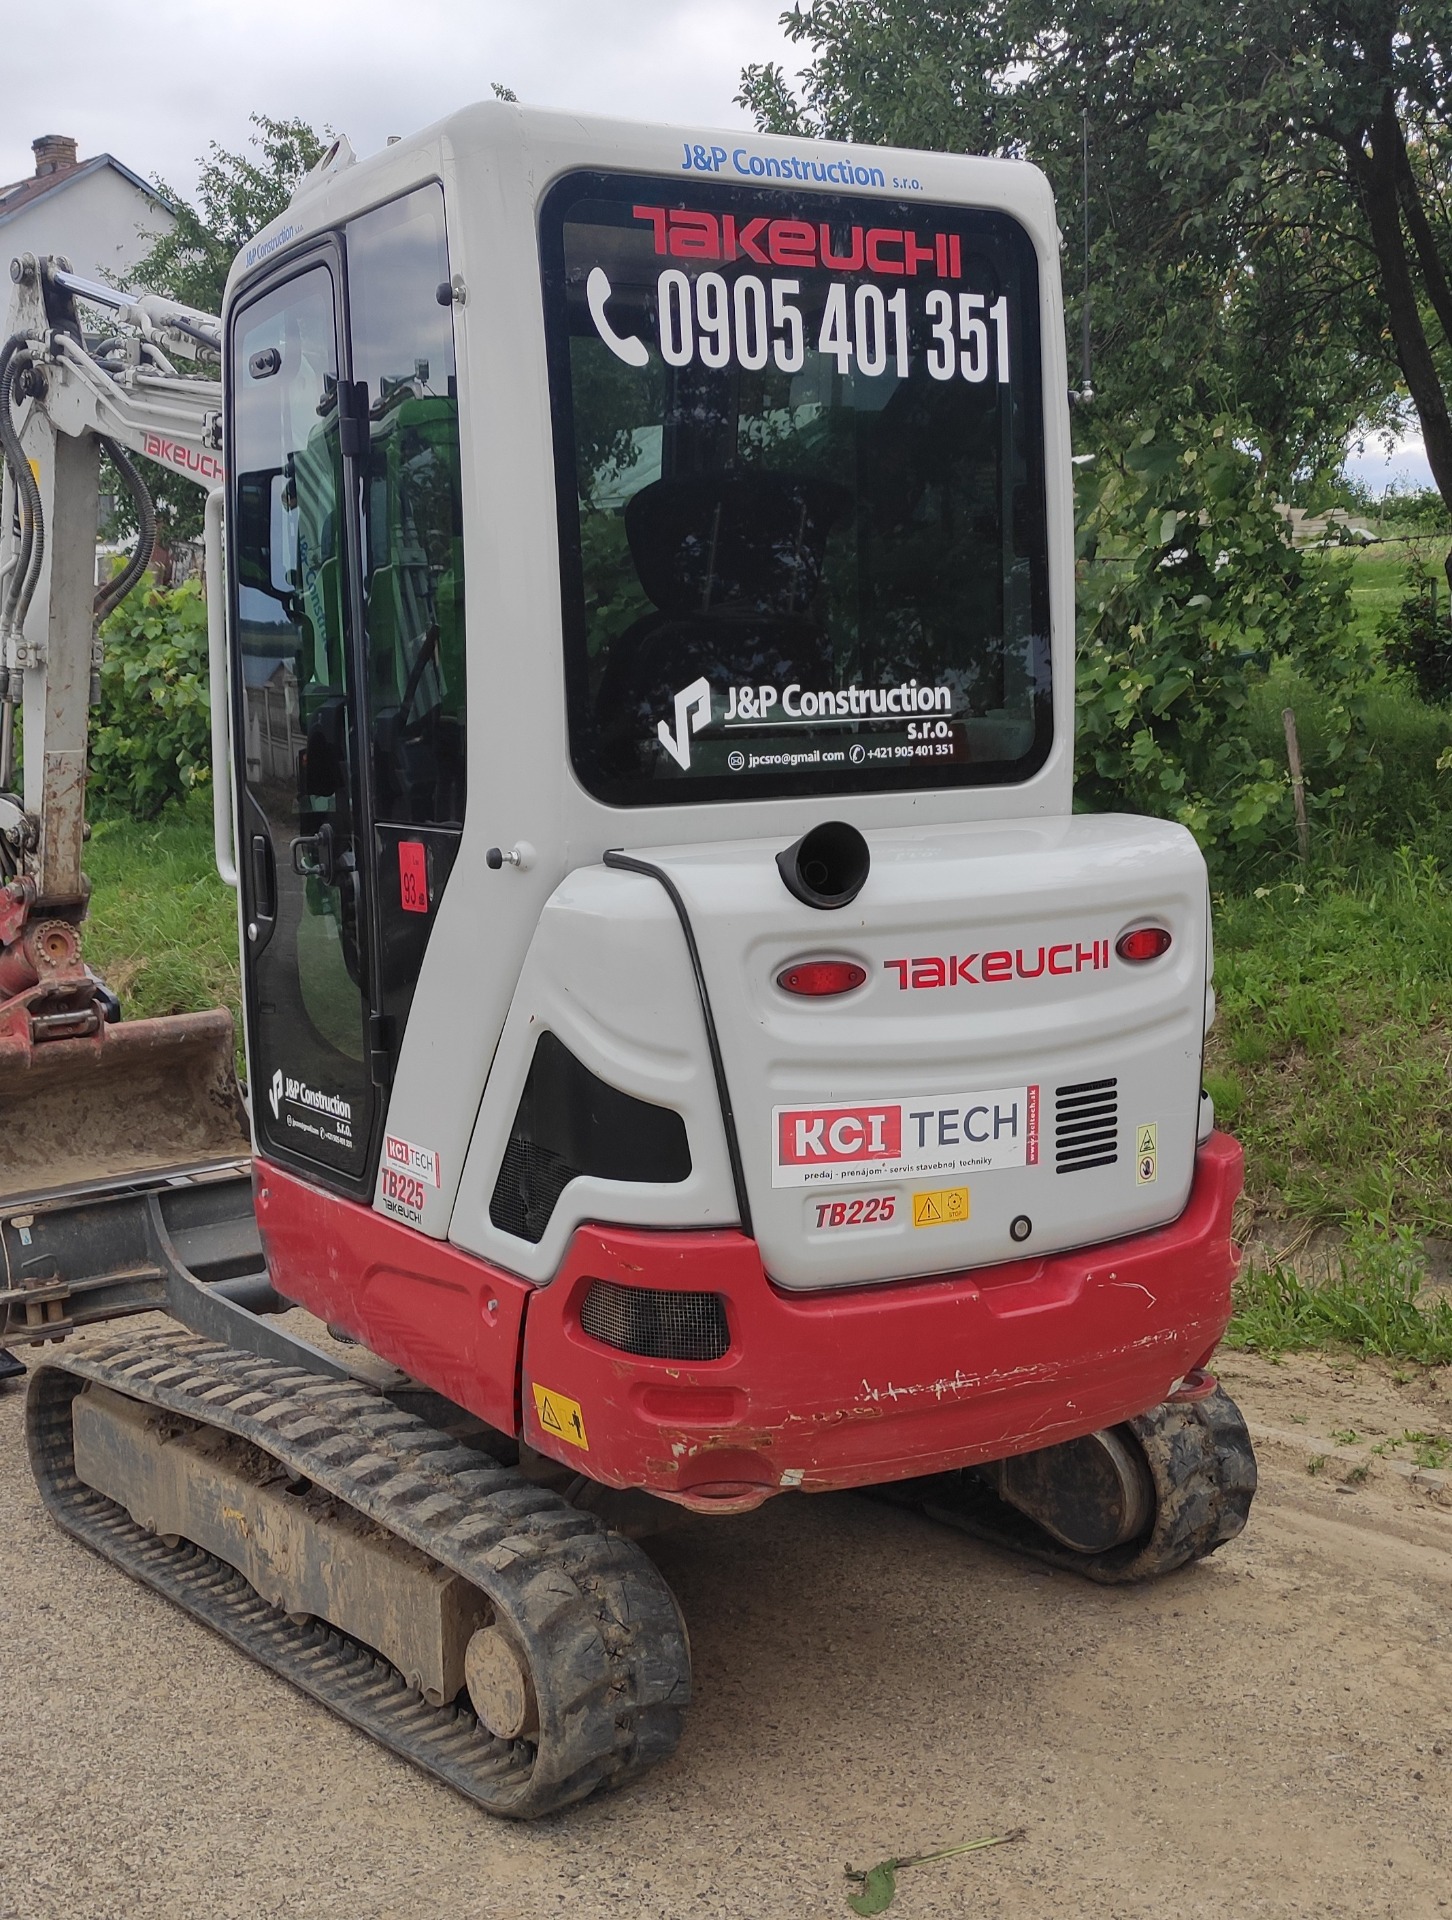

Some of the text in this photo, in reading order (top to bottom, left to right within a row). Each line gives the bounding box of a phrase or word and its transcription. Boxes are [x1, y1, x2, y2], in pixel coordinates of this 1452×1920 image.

[681, 144, 924, 191] J&P Construction s.r.o.
[257, 225, 294, 259] Construction
[657, 269, 1011, 383] 0905 401 351
[724, 678, 951, 720] J&P Construction
[907, 721, 953, 740] s.r.o.
[867, 748, 893, 759] +421
[895, 746, 914, 757] 905
[915, 745, 934, 756] 401
[936, 744, 954, 755] 351
[404, 872, 416, 905] 93
[285, 1077, 351, 1119] J&P Construction
[336, 1121, 352, 1137] s.r.o.
[795, 1103, 1018, 1157] KCI TECH
[389, 1139, 407, 1161] KCI
[410, 1149, 433, 1172] TECH
[804, 1169, 833, 1181] predaj
[841, 1166, 882, 1179] prenájom
[889, 1165, 914, 1174] servis
[959, 1157, 992, 1168] techniky
[382, 1167, 424, 1210] TB225
[815, 1196, 896, 1228] TB225
